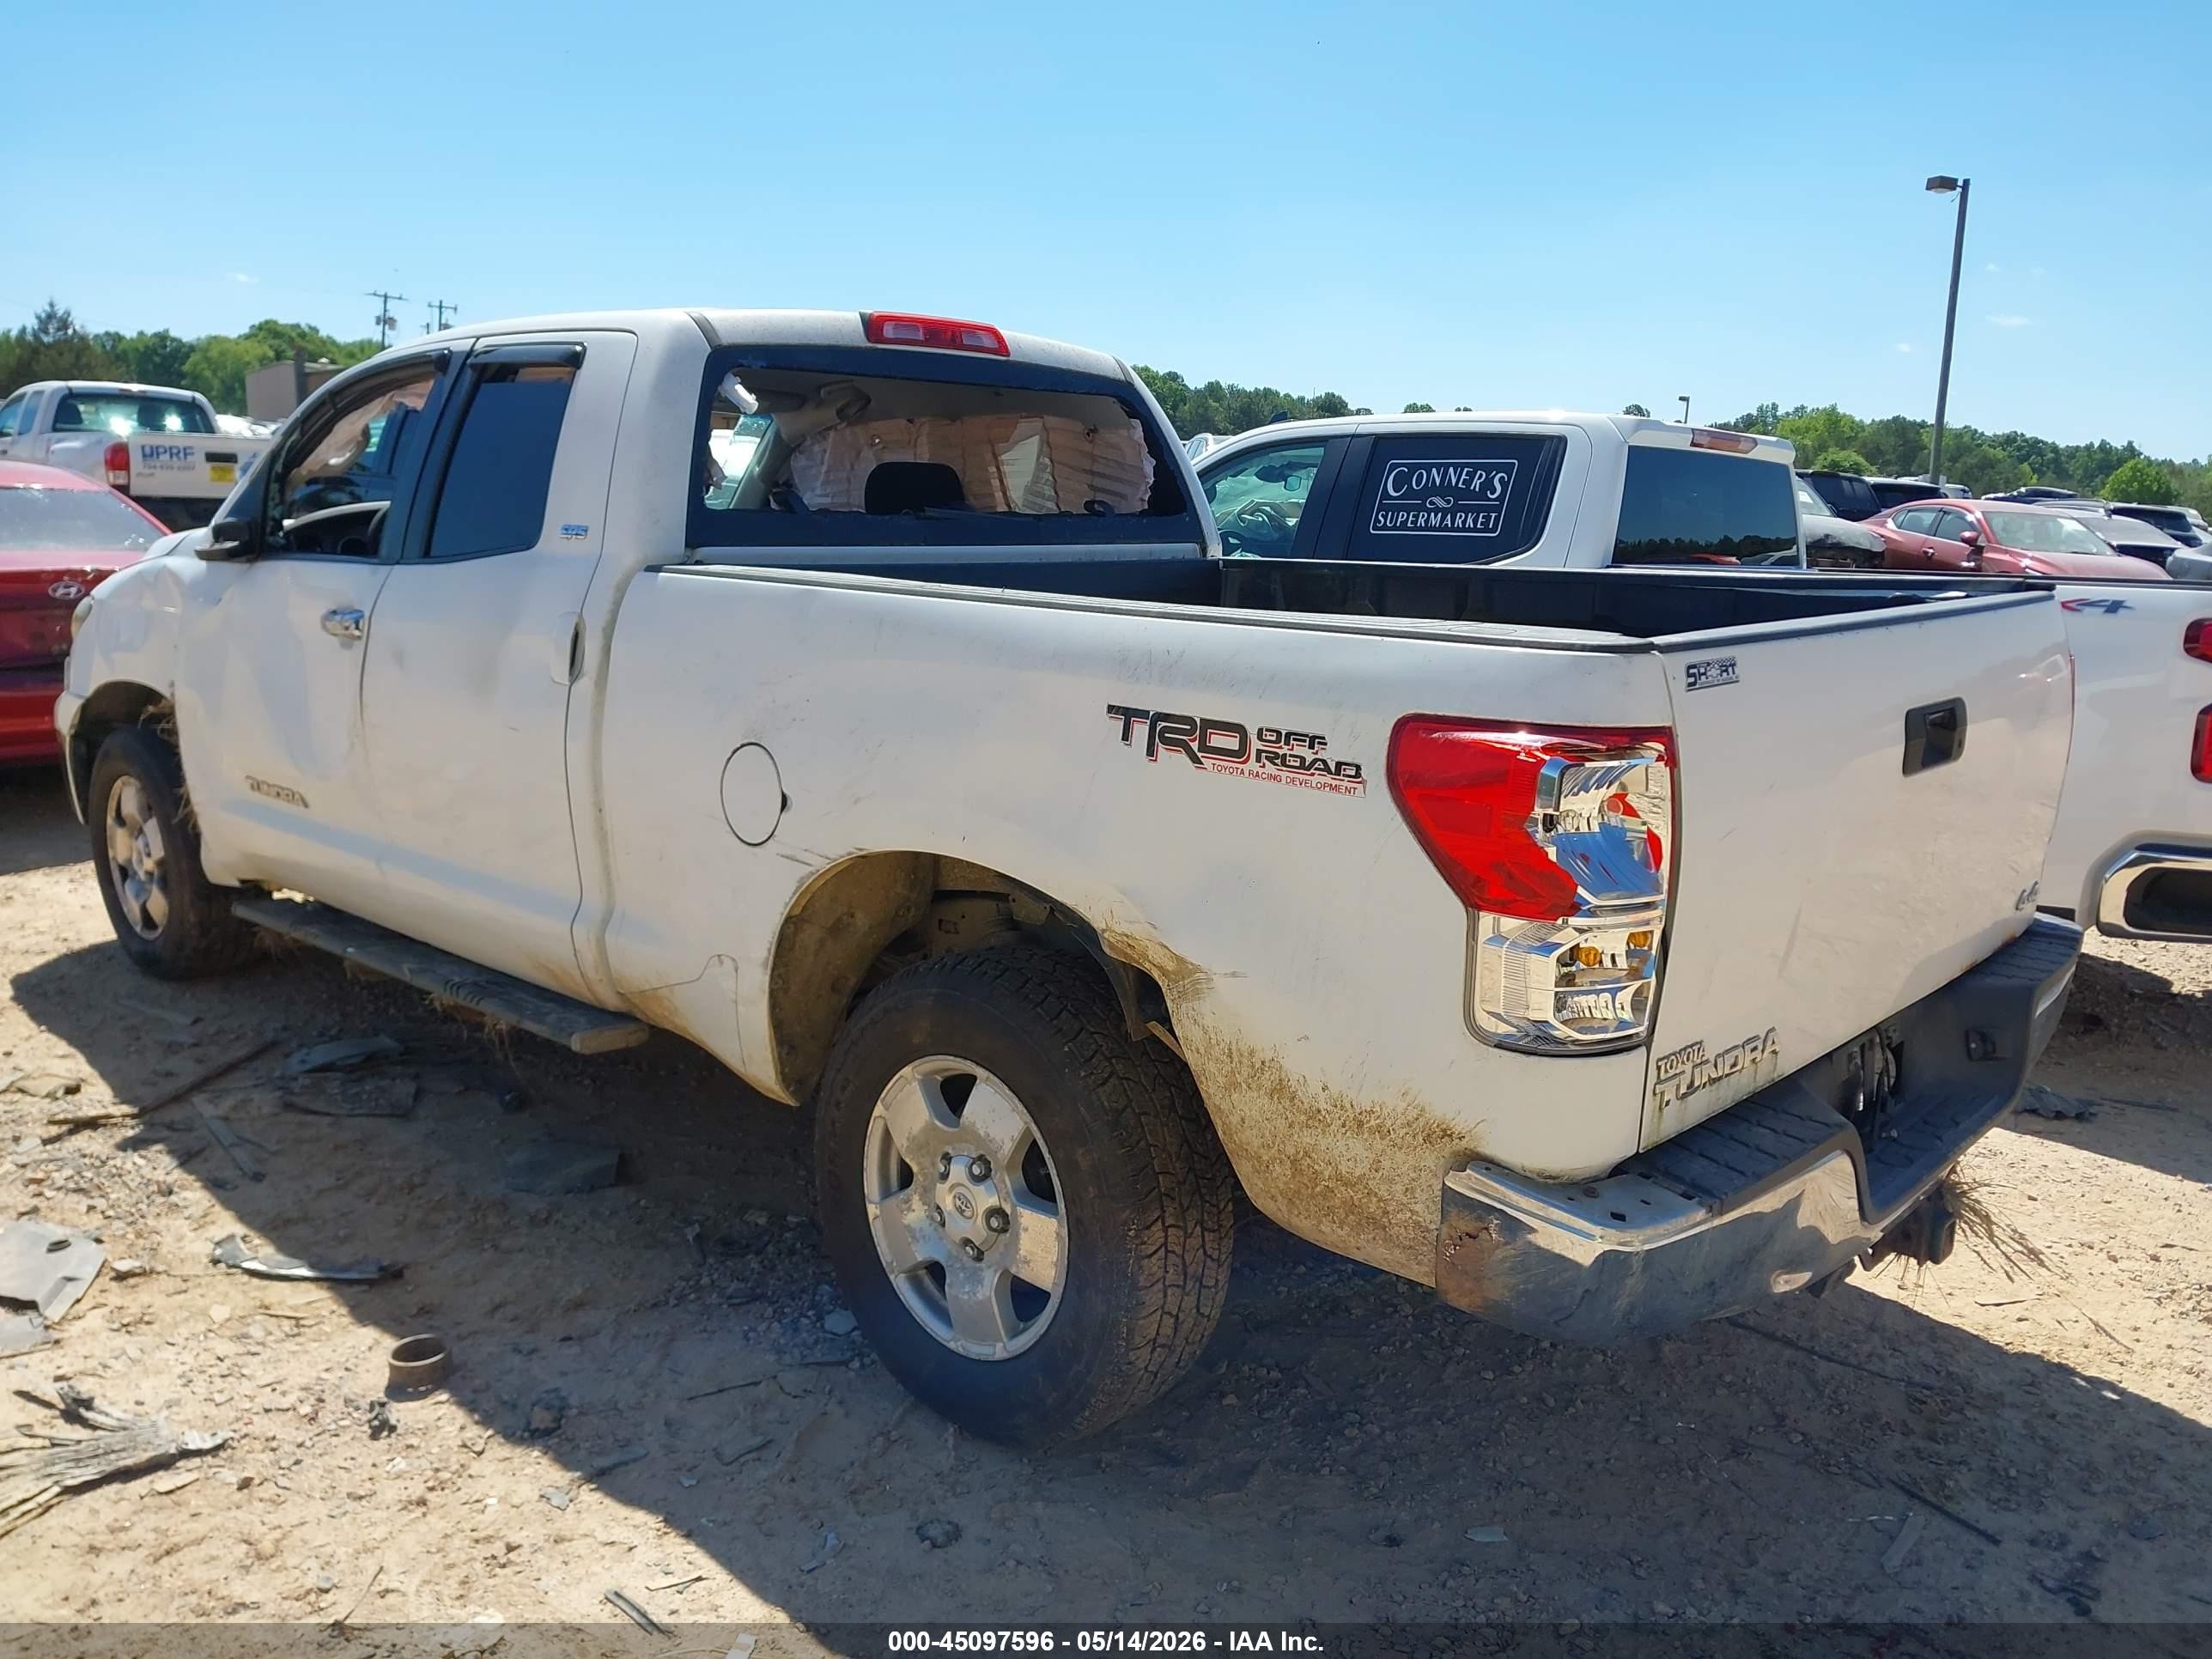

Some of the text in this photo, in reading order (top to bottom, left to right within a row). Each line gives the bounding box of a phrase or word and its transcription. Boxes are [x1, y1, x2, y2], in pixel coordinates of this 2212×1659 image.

[1386, 466, 1509, 499] CONNER'S
[1376, 511, 1498, 530] SUPERMARKET
[1106, 702, 1252, 770] TRD
[1256, 726, 1328, 755] OFF
[1210, 762, 1358, 796] TOYOTA RACING DEVELOPMENT
[1255, 748, 1364, 785] ROAD
[1654, 1026, 1781, 1109] TUNDRA
[1656, 1040, 1707, 1079] TOYOTA
